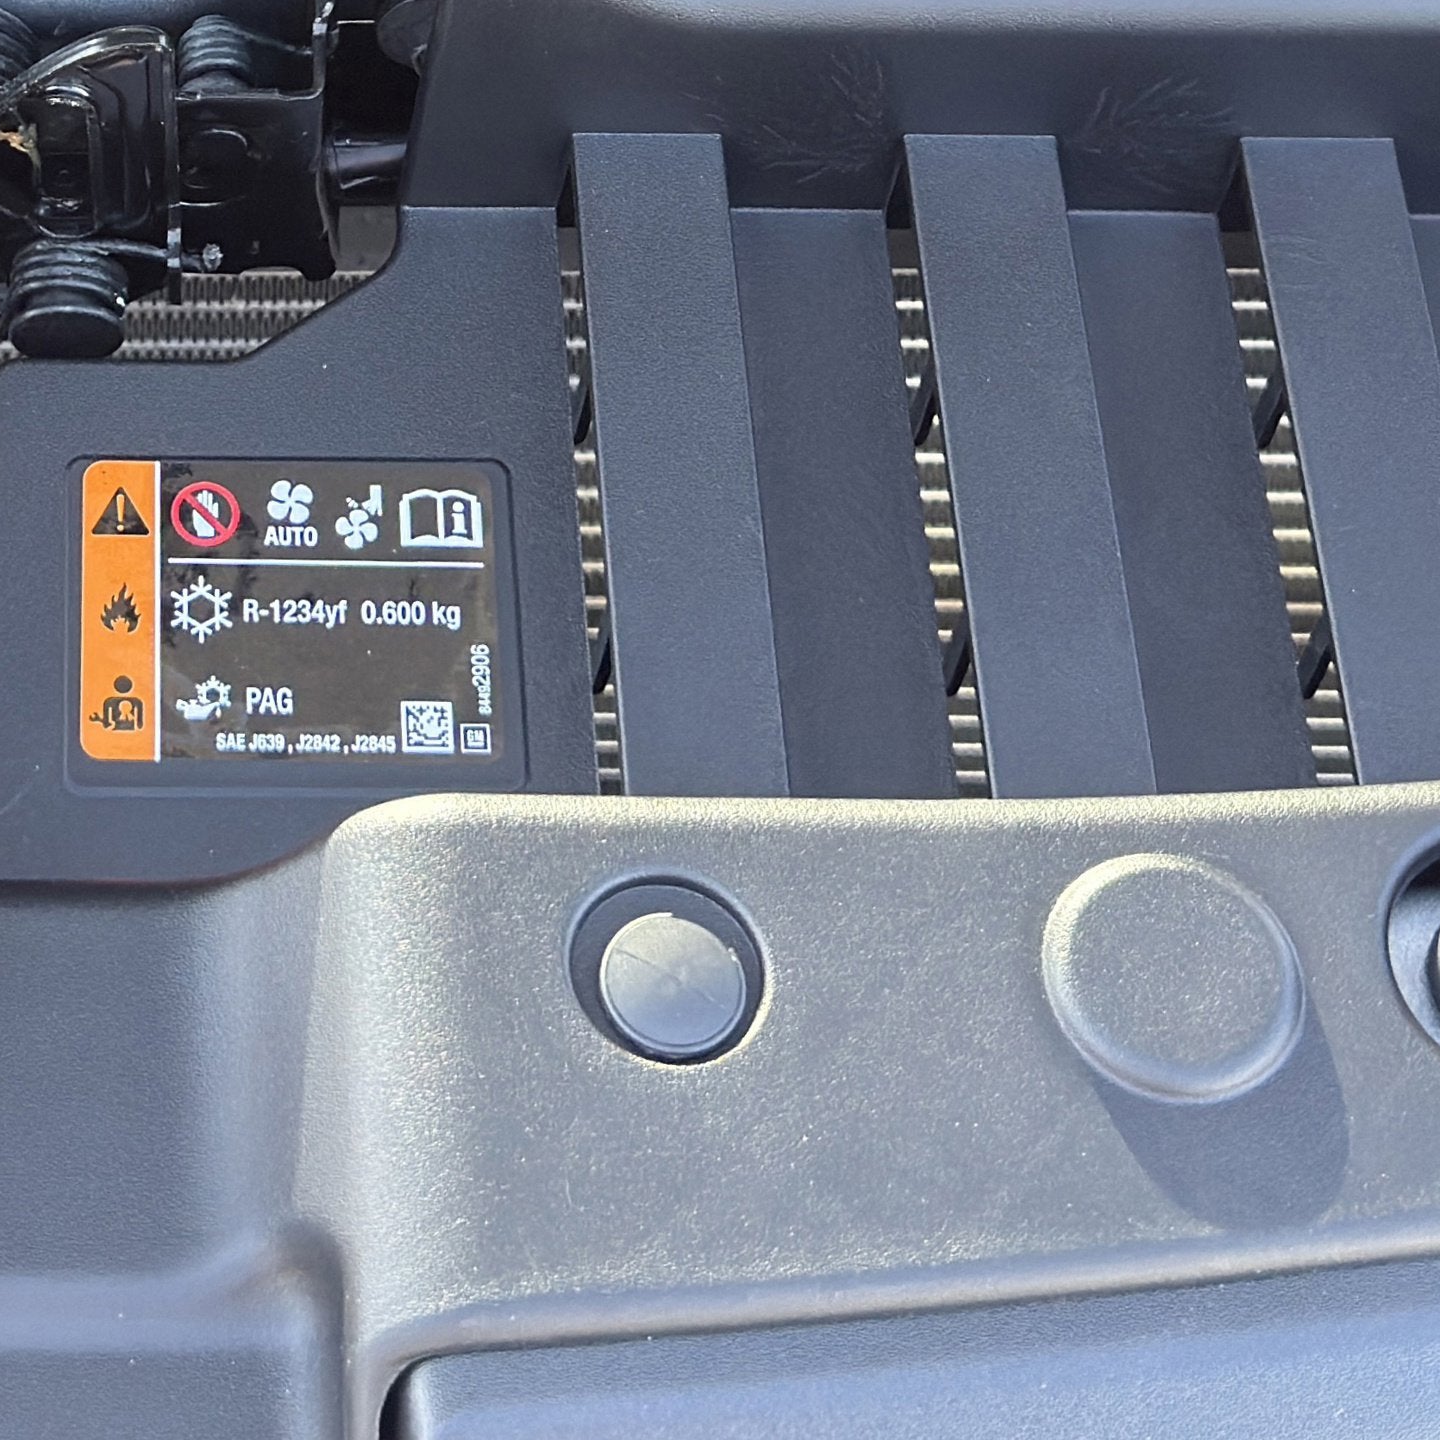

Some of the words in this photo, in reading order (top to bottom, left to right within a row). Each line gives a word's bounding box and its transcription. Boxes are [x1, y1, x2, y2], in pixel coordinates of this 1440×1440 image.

[264, 525, 319, 548] AUTO
[242, 598, 348, 627] R-1234yf
[360, 600, 426, 626] 0.600
[431, 601, 462, 630] kg
[245, 687, 294, 715] PAG
[215, 732, 246, 752] SAE
[351, 734, 397, 753] J2845
